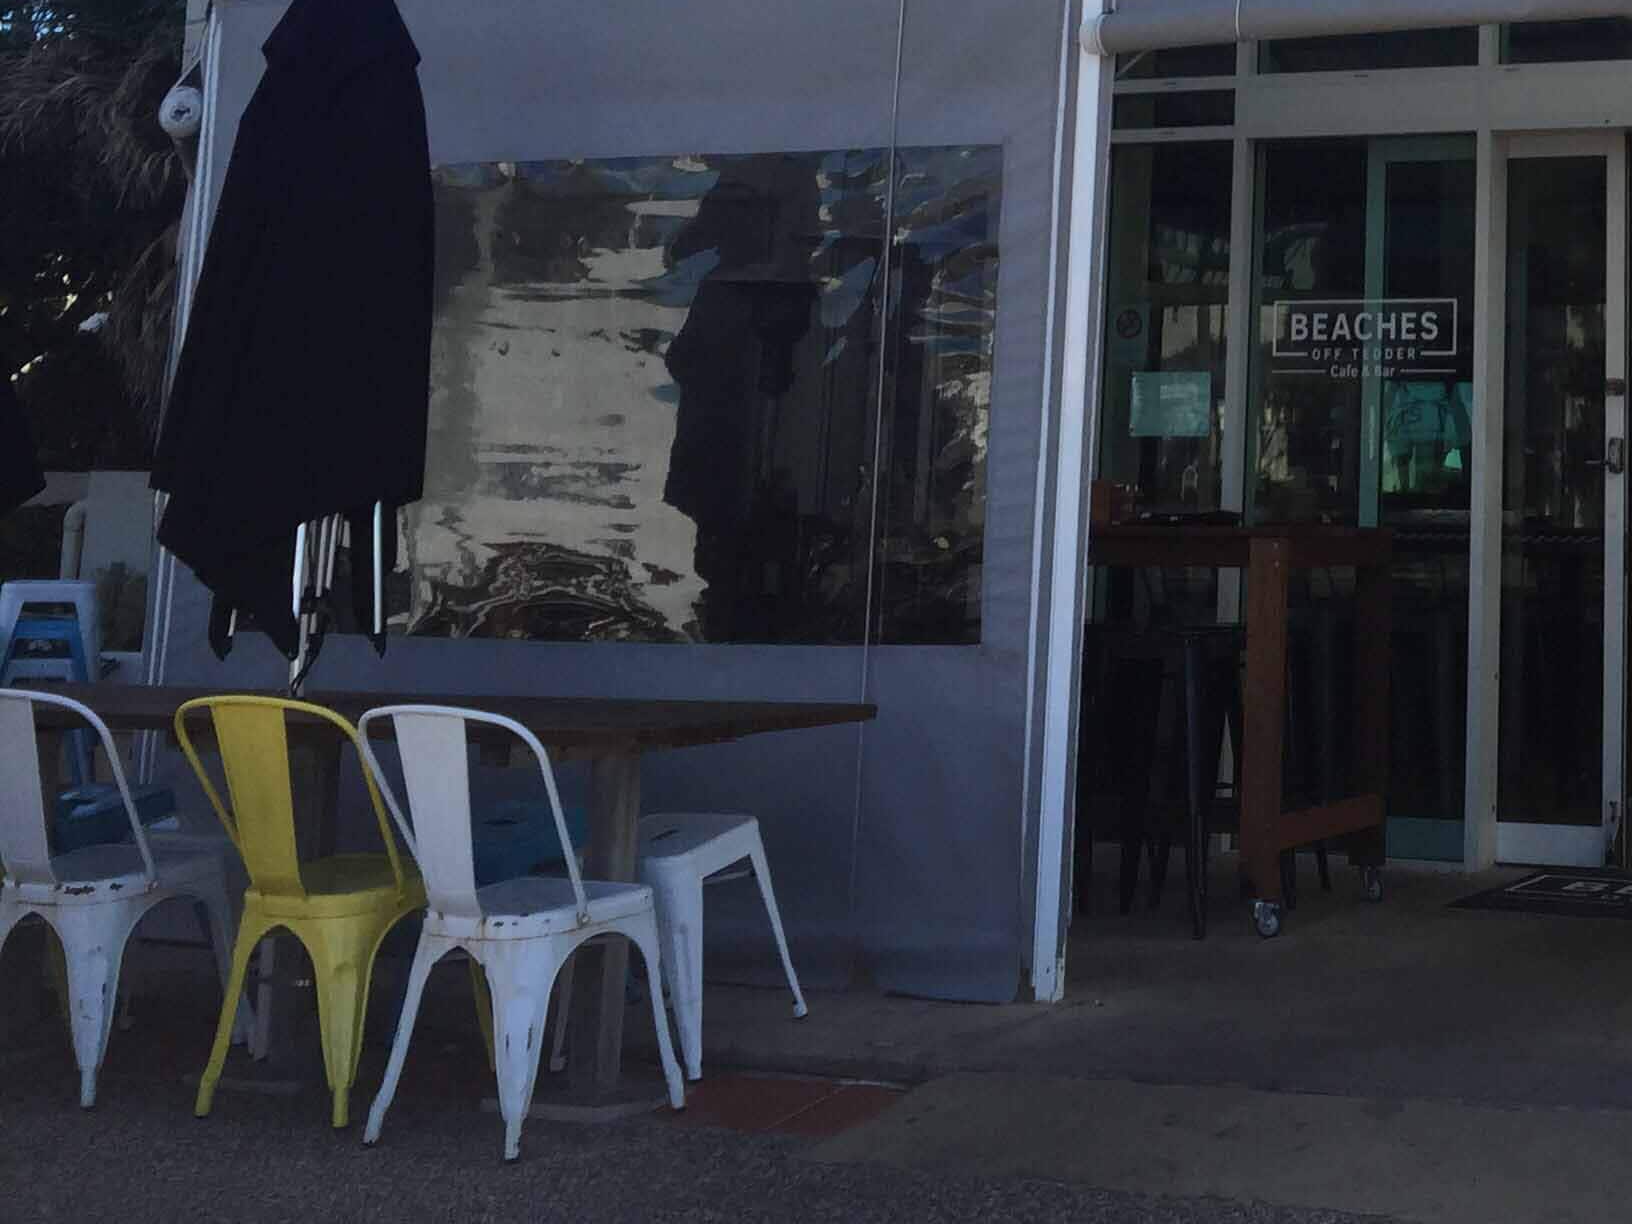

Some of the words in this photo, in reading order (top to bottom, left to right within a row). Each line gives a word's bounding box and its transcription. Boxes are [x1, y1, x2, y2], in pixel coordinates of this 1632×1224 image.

[1290, 311, 1440, 343] BEACHES
[1312, 347, 1342, 361] OFF
[1330, 364, 1359, 377] Cafe
